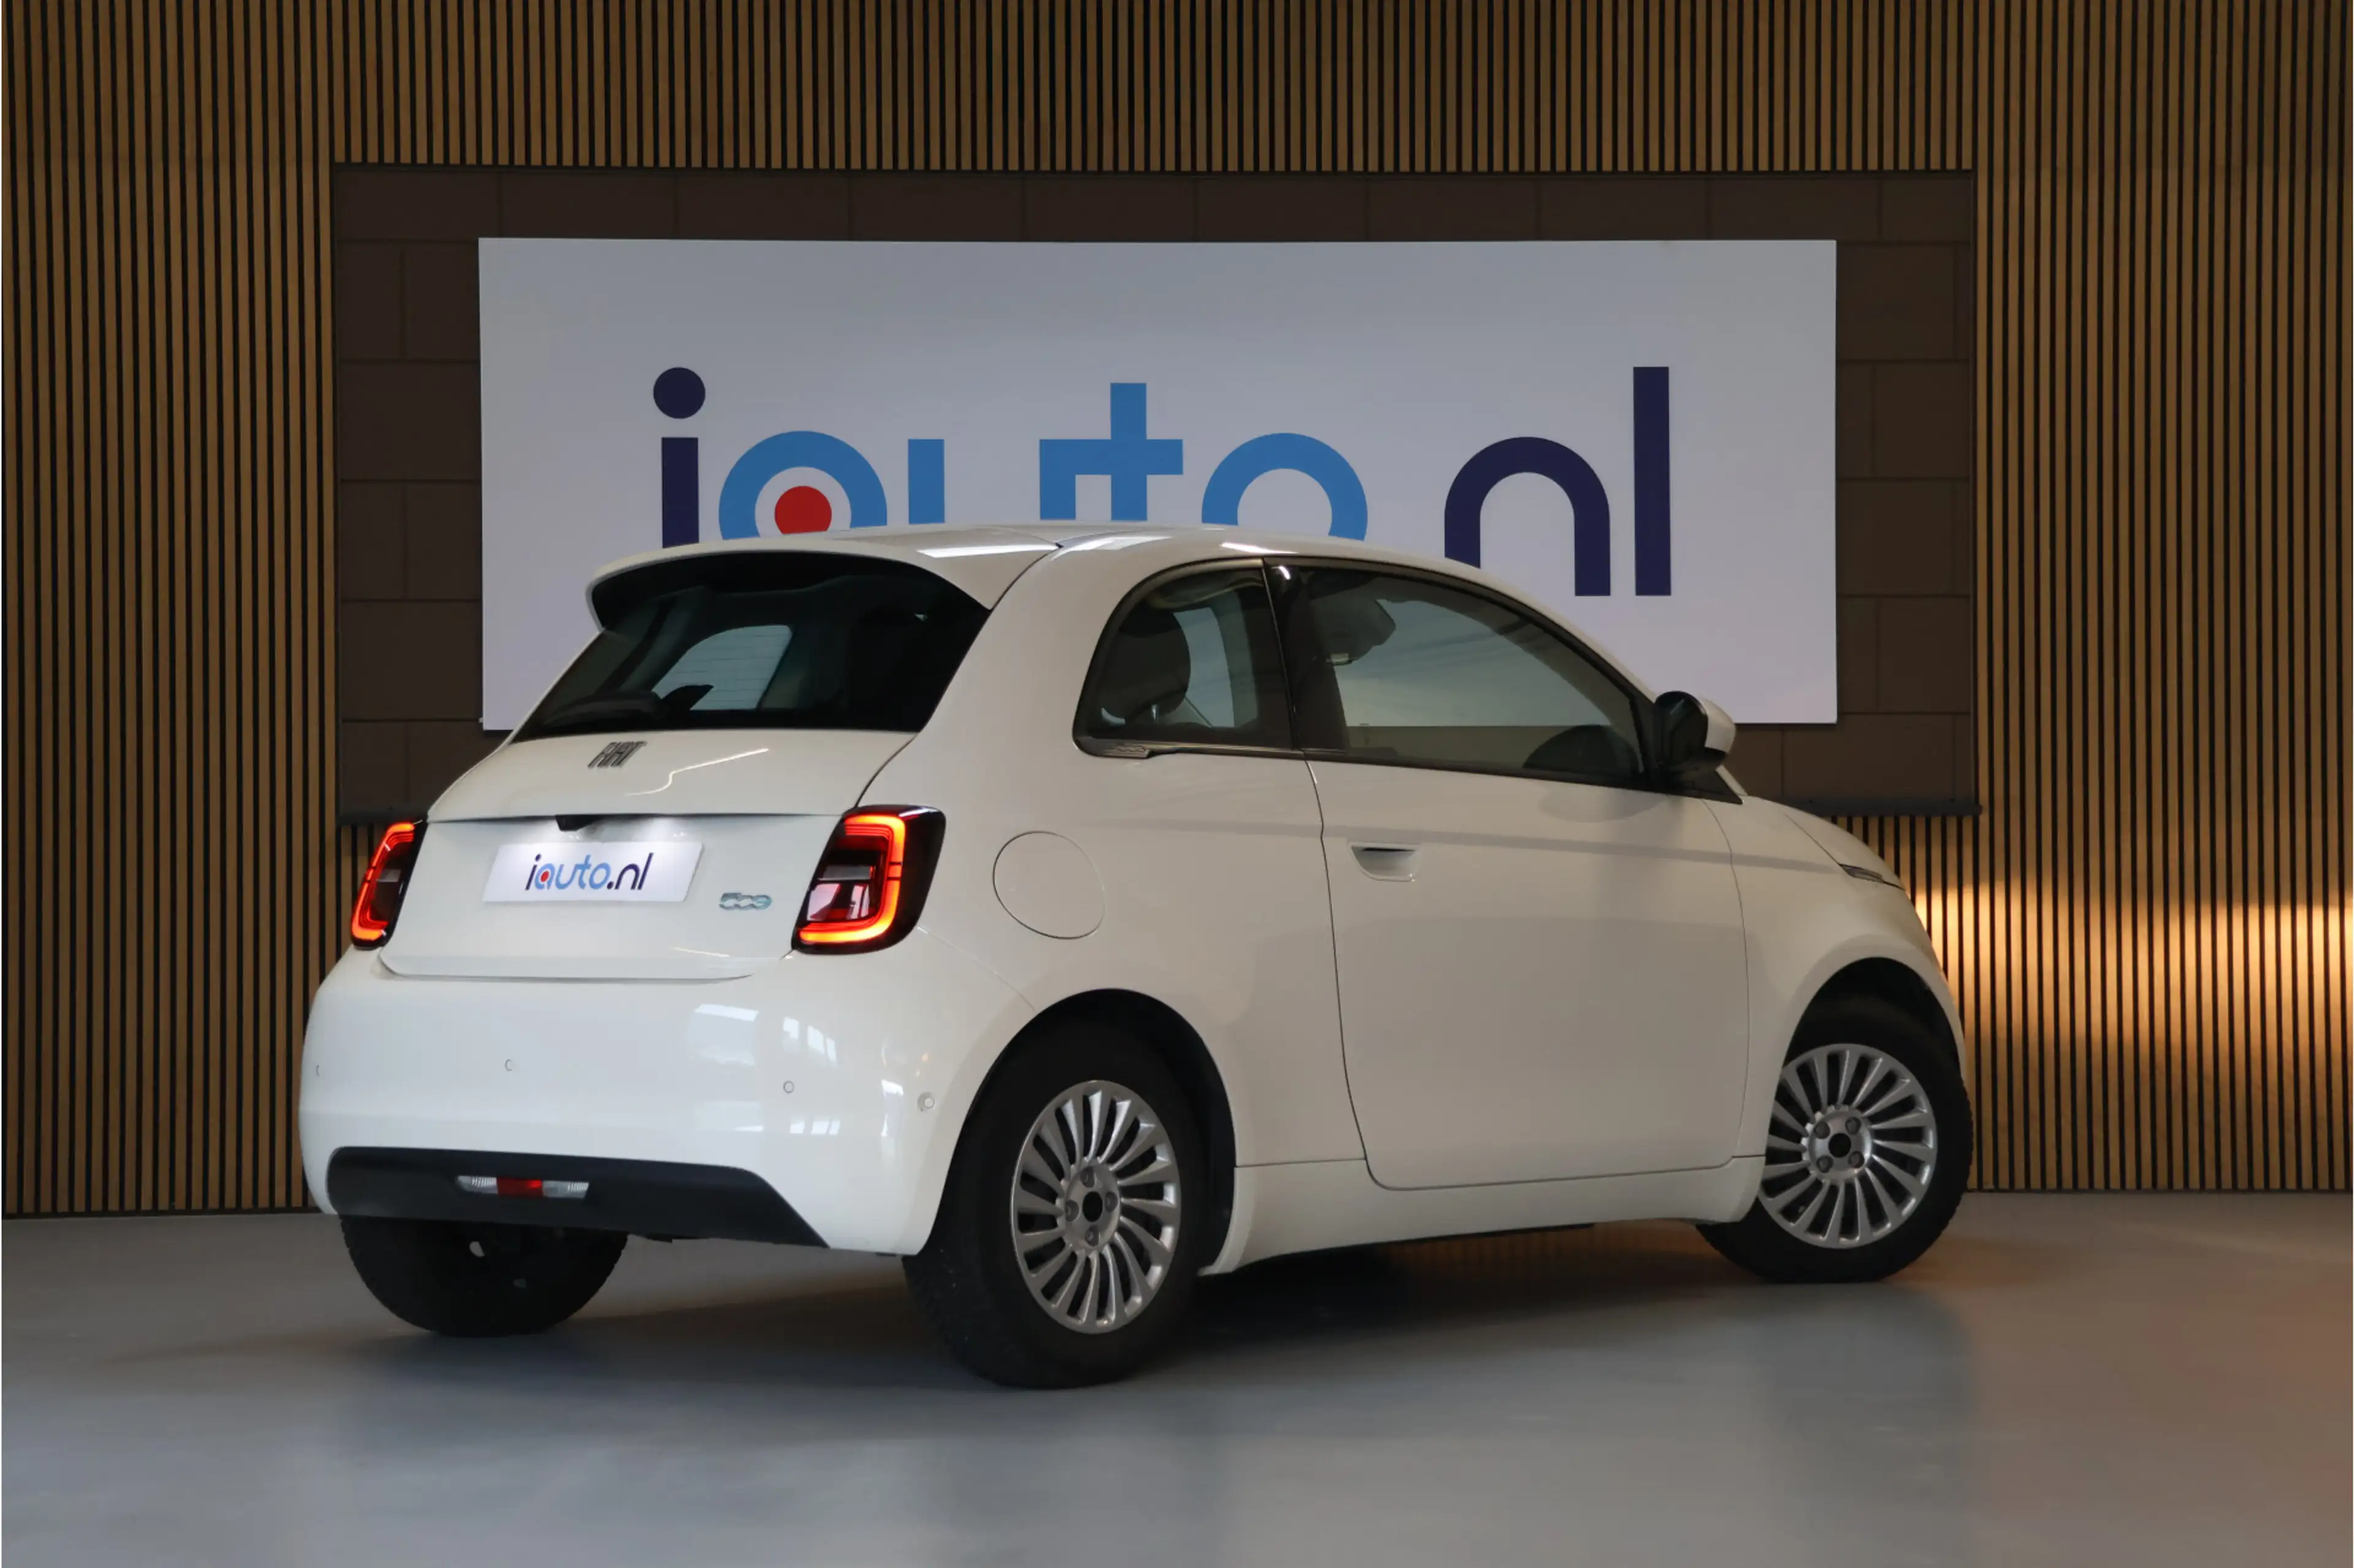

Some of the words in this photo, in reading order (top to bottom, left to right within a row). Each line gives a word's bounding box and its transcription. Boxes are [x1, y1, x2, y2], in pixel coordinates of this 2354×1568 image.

[653, 367, 1672, 596] iautonl
[587, 741, 647, 768] FIAT
[525, 852, 654, 891] iauto.nl
